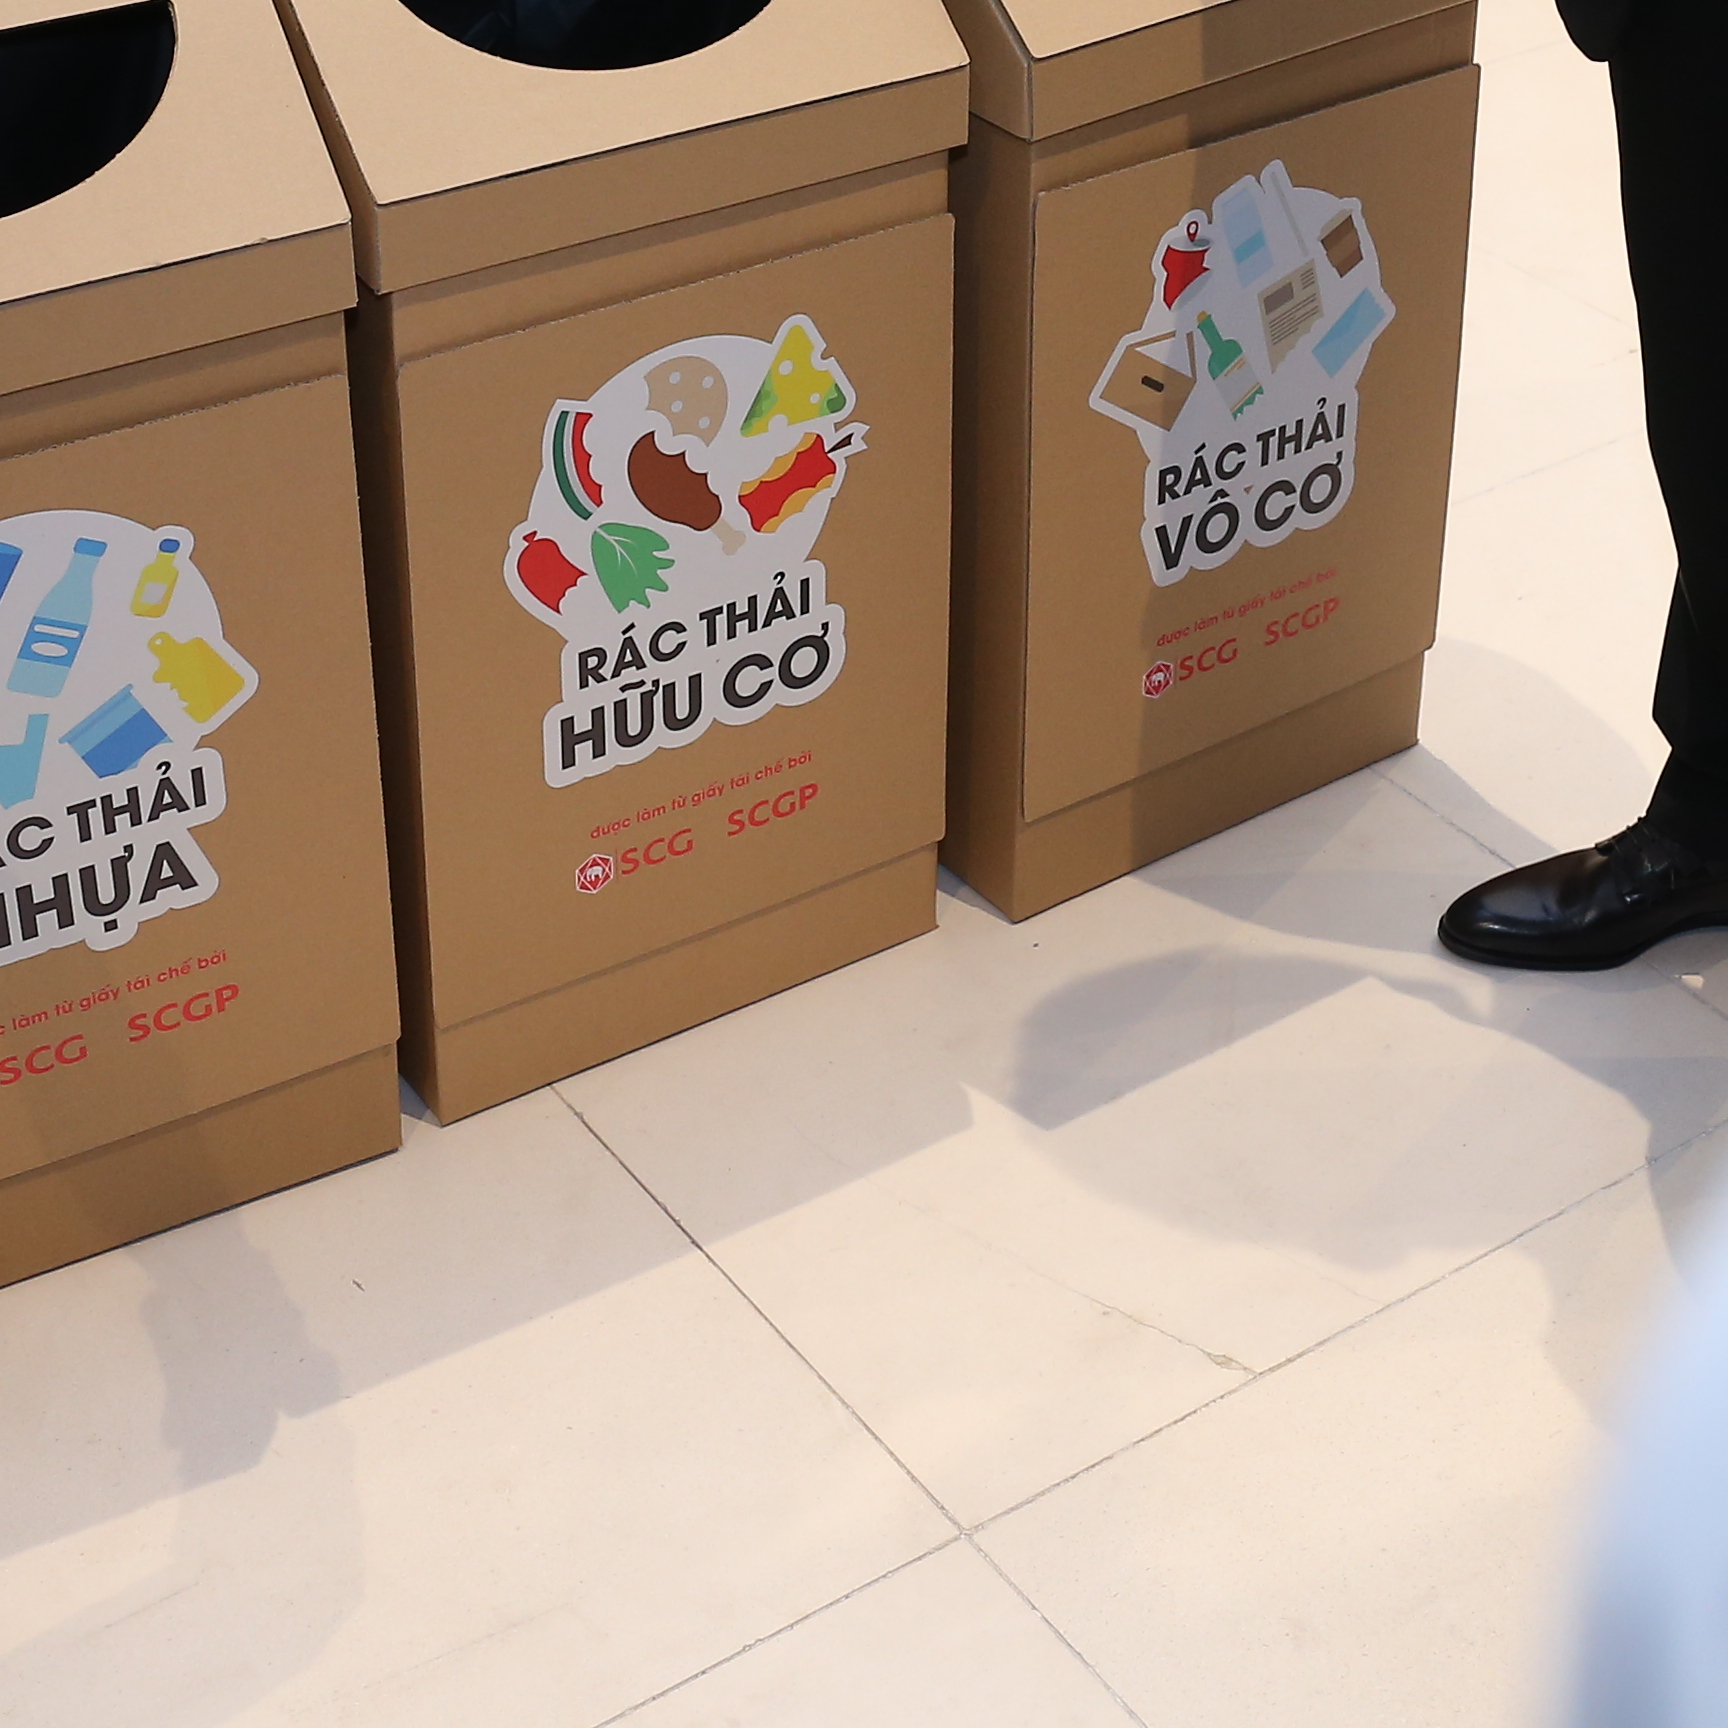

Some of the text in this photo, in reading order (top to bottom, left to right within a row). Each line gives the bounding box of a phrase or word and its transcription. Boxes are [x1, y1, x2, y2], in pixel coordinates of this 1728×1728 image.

[1158, 397, 1345, 505] RÁC THẢI
[1155, 451, 1343, 570] VÔ CƠ
[579, 572, 809, 693] RÁC THẢI
[1178, 597, 1339, 680] SCG SCGP
[561, 622, 830, 770] HỮU CƠ
[67, 761, 210, 843] THẢI
[591, 750, 812, 839] được làm từ giấy tái chế bởi
[619, 782, 819, 875] SCG SCGP
[13, 1009, 49, 1030] làm
[54, 999, 73, 1016] từ
[79, 984, 120, 1013] giấy
[126, 975, 151, 992] tái
[156, 957, 192, 983] chế
[197, 949, 227, 970] bởi
[126, 983, 240, 1042] SCGP
